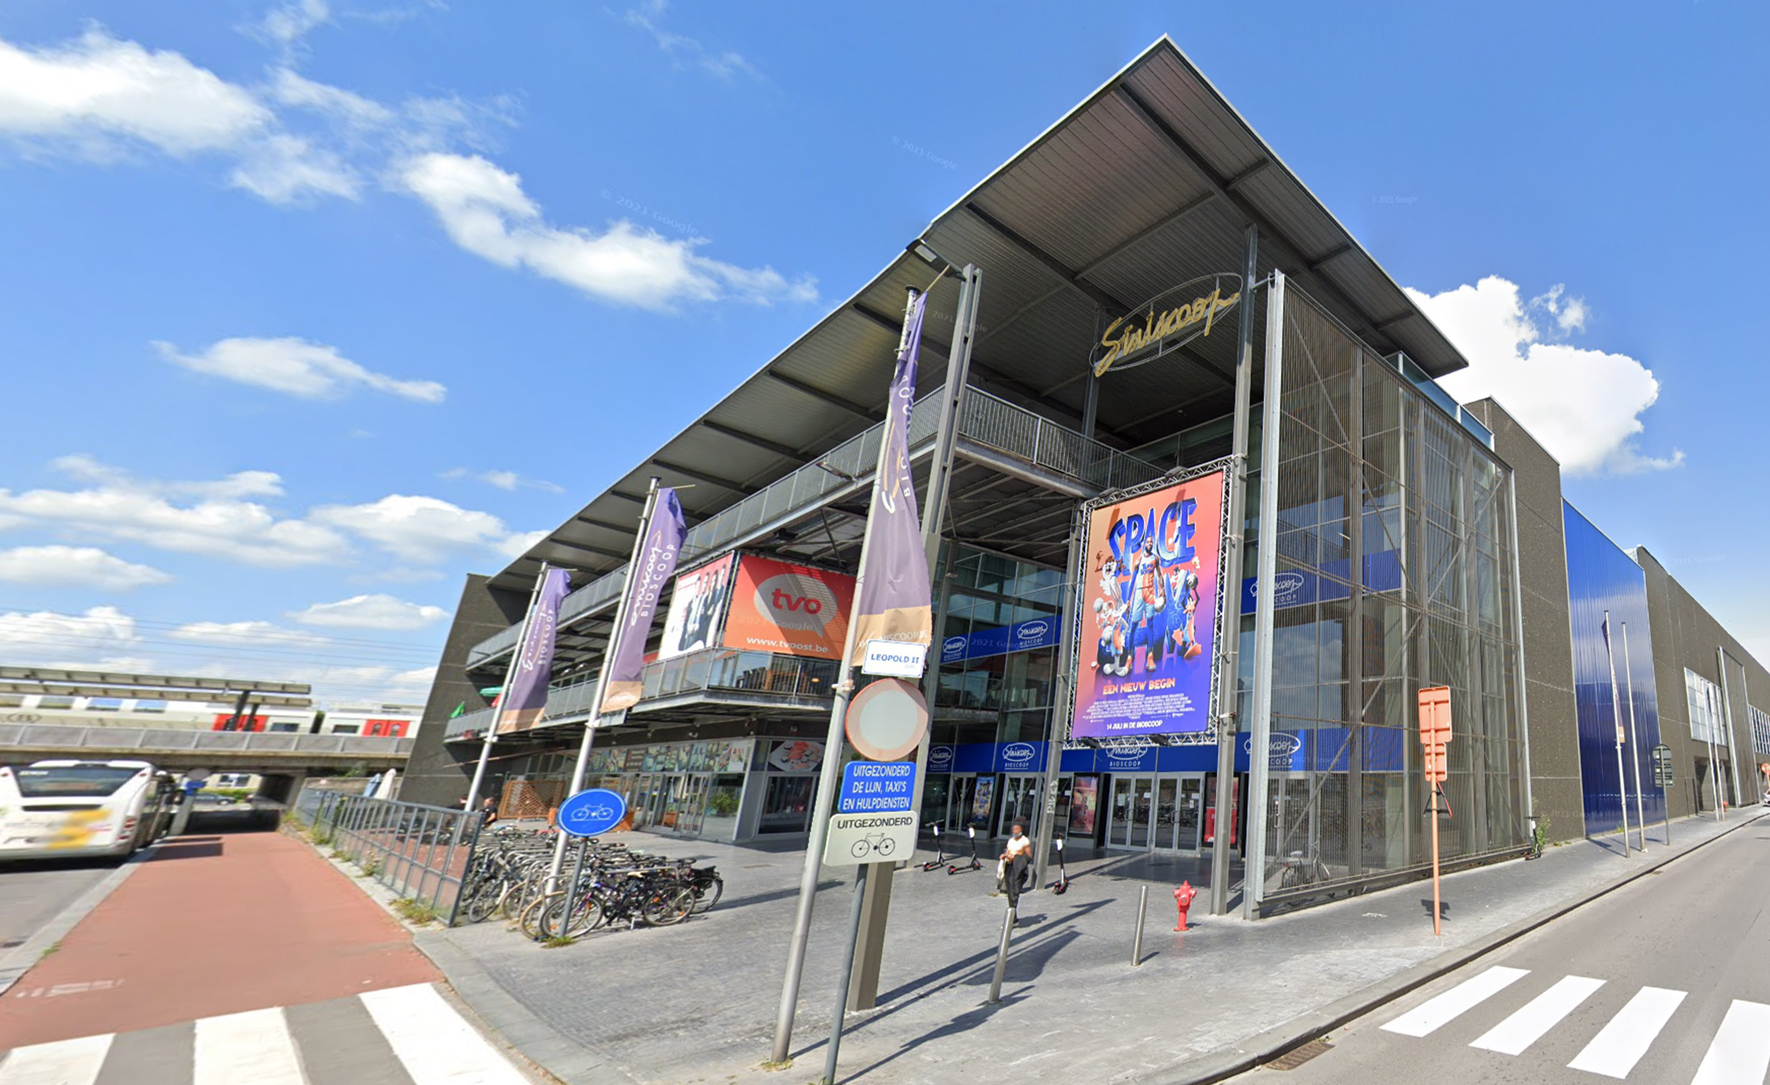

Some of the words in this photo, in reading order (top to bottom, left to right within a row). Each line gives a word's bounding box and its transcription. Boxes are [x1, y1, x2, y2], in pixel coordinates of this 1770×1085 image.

[1108, 496, 1198, 578] SPACE
[640, 544, 677, 617] BIOSCOOP
[772, 587, 822, 615] tvo
[746, 637, 829, 653] www.tvoost.be
[871, 653, 910, 663] LEOPOLD
[911, 656, 920, 664] II
[1102, 684, 1119, 695] EEN
[1120, 681, 1147, 693] NIEUW
[1148, 677, 1176, 690] BEGIN
[853, 765, 911, 777] UITGEZONDERD
[852, 781, 864, 794] DE
[864, 781, 883, 795] LIJN,
[885, 781, 907, 793] TAXI'S
[842, 798, 855, 810] EN
[855, 797, 910, 810] HULPDIENSTEN
[837, 816, 913, 829] UITGEZONDERD
